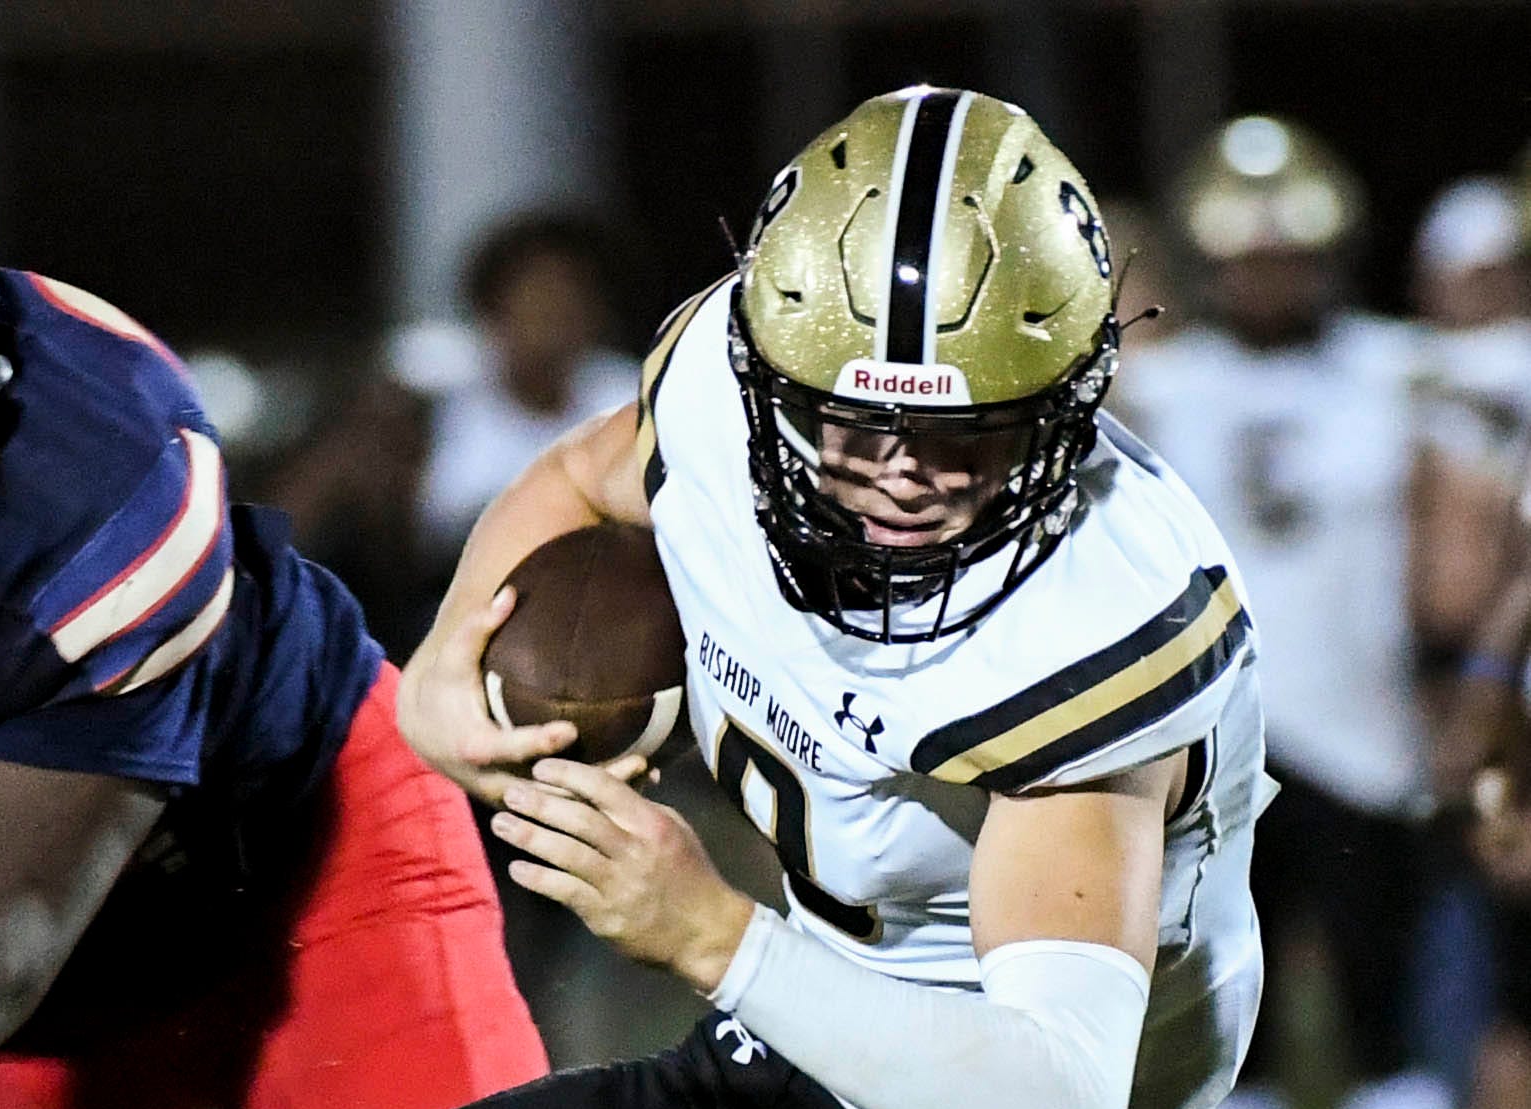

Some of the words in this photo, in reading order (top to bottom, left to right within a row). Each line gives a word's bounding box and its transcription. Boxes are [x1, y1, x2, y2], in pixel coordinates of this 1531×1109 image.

[854, 369, 952, 395] Riddell
[699, 631, 762, 708] BISHOP
[765, 693, 823, 772] MOORE
